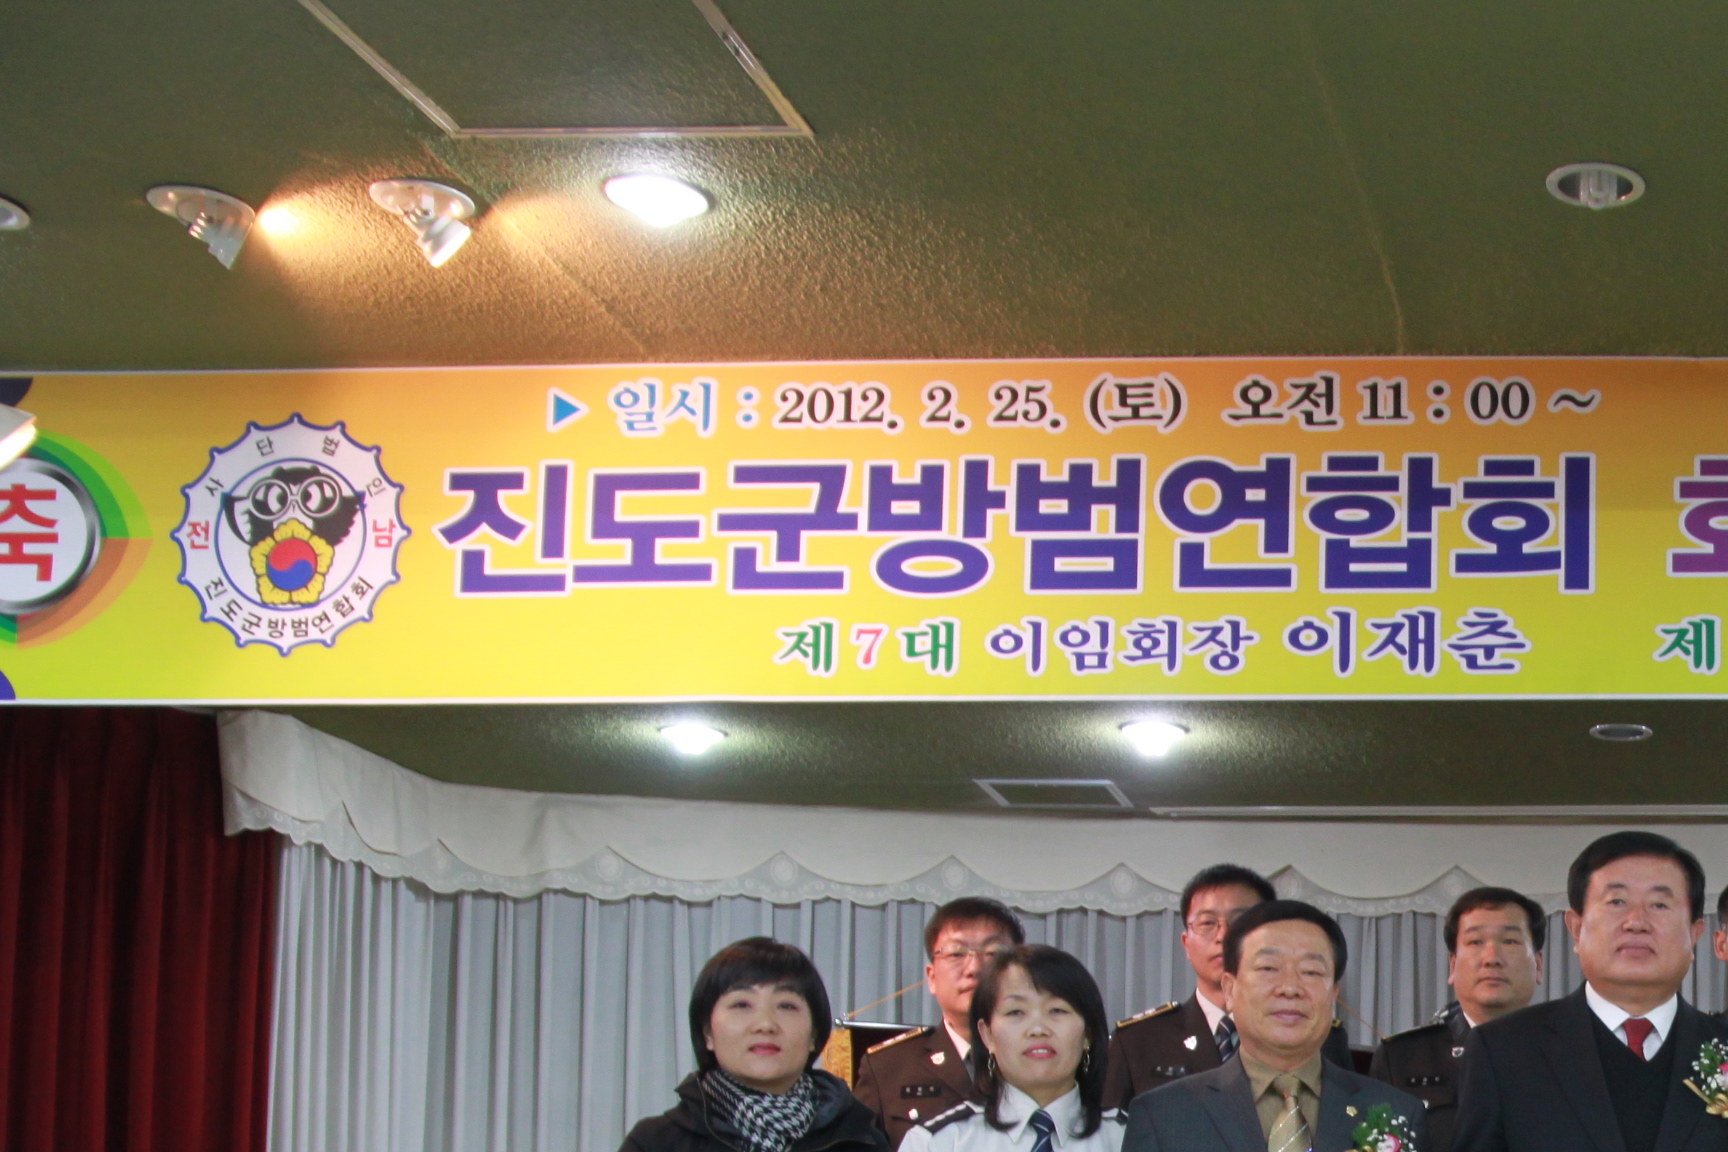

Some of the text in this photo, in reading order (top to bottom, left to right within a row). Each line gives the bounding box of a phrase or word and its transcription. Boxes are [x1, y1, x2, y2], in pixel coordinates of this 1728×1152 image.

[615, 384, 716, 431] 일시
[781, 388, 898, 429] 2012.
[928, 388, 965, 428] 2.
[994, 387, 1061, 428] 25.
[1090, 380, 1183, 428] (토)
[1228, 376, 1338, 426] 오전
[0, 484, 58, 581] 축
[439, 455, 1592, 593] 진도군방범연합회
[204, 576, 374, 639] 진도군방범연합회
[990, 620, 1254, 672] 이임회장
[1288, 610, 1526, 673] 이재춘
